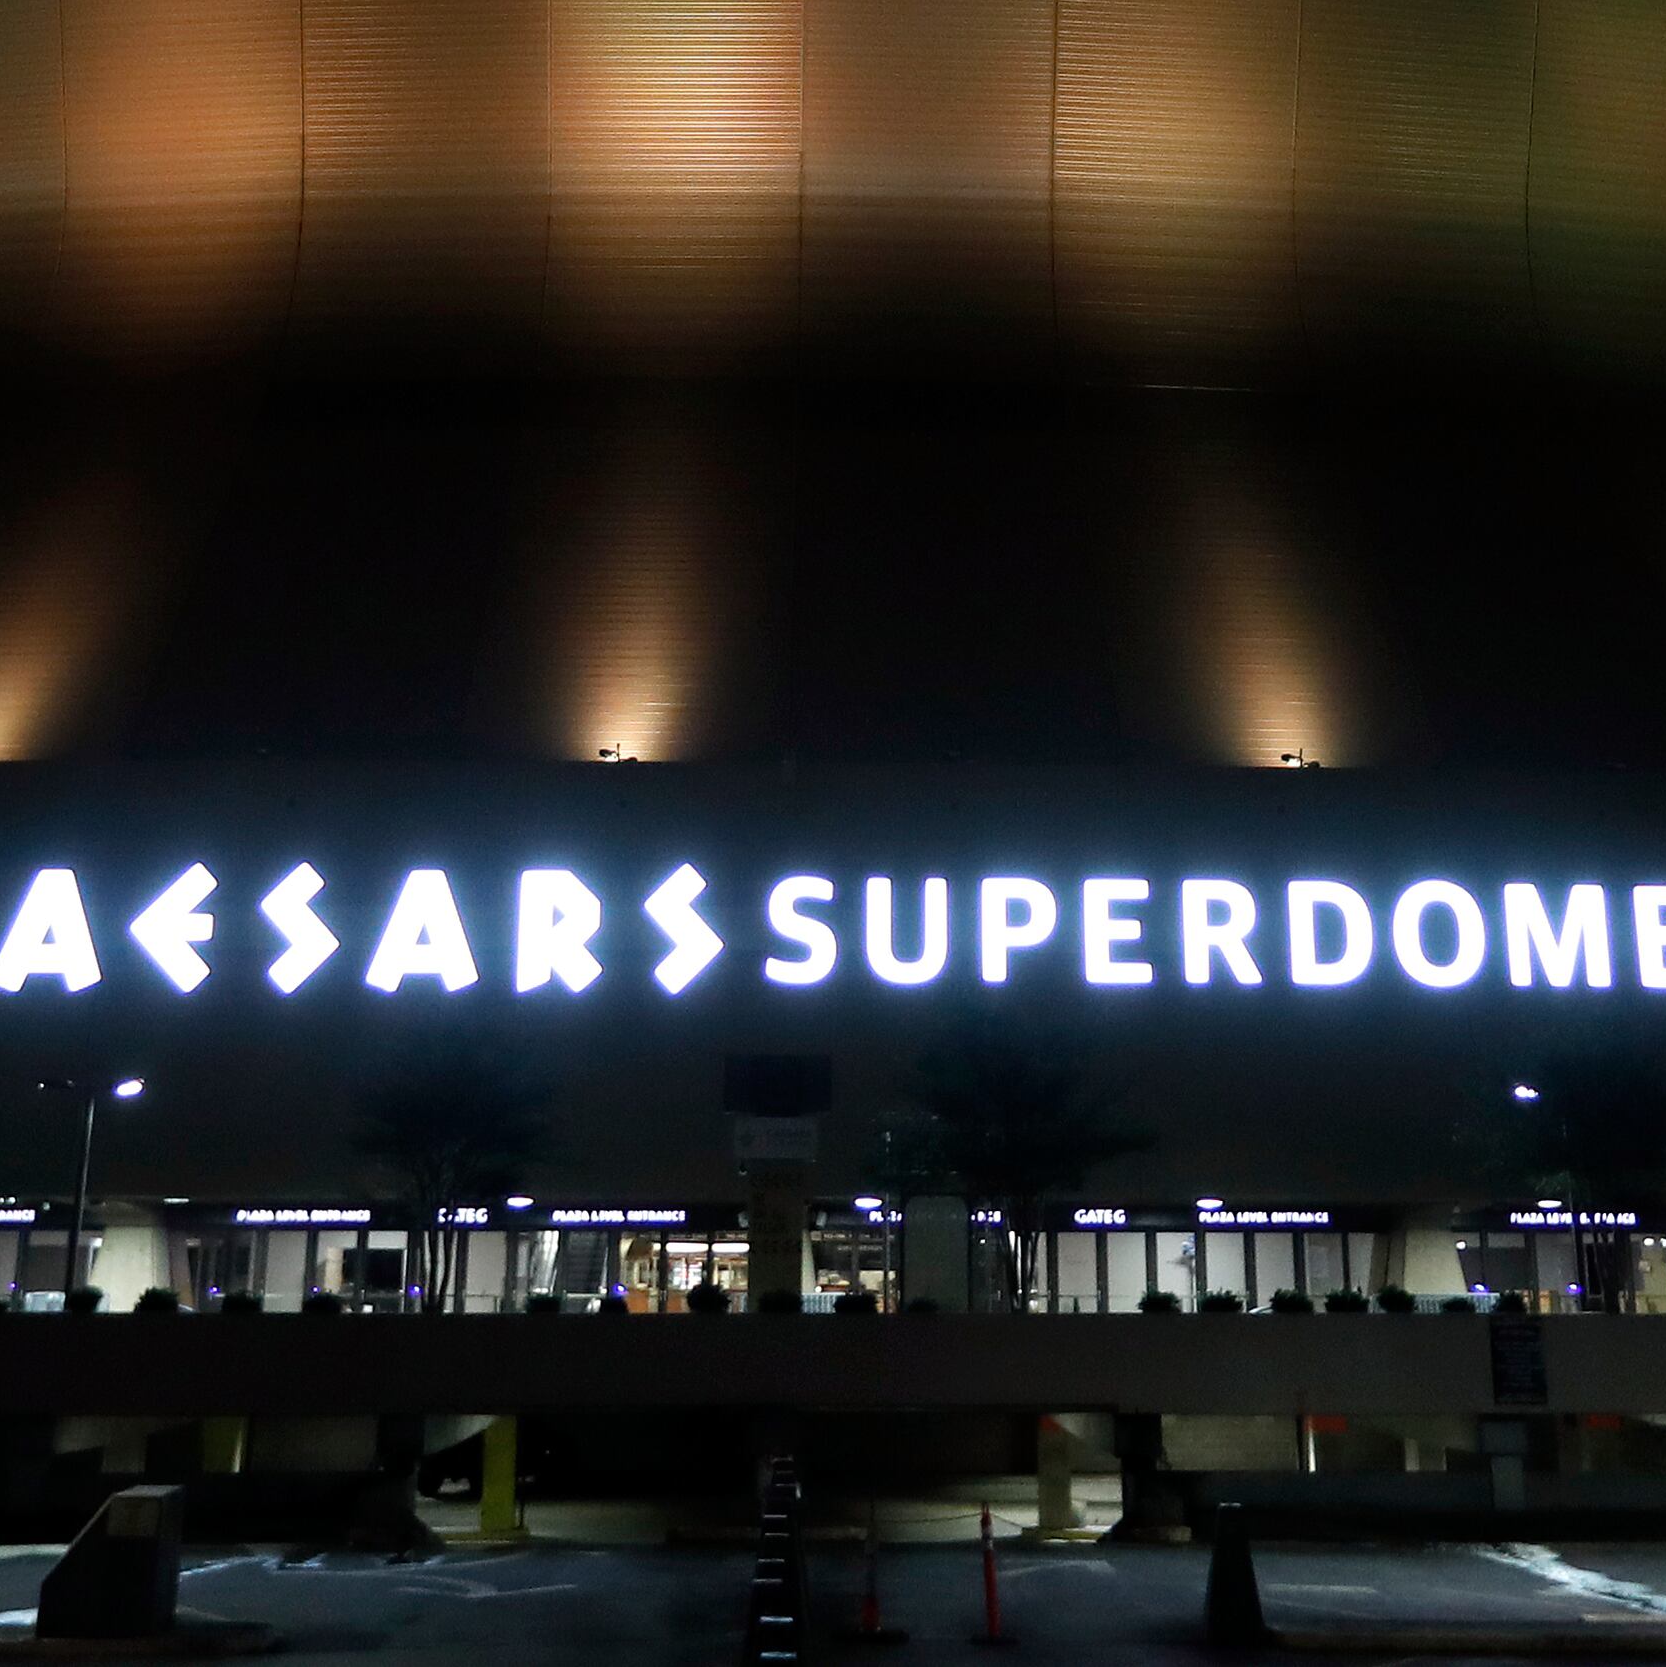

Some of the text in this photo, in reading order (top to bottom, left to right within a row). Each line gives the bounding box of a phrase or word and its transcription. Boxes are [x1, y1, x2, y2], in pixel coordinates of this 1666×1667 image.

[552, 1210, 590, 1222] PLAZA
[626, 1210, 686, 1222] ENTRANCE
[1198, 1212, 1329, 1223] PLAZA LEVEL ENTRANCE
[1510, 1212, 1545, 1224] PLAZA
[1546, 1212, 1574, 1224] LEVE
